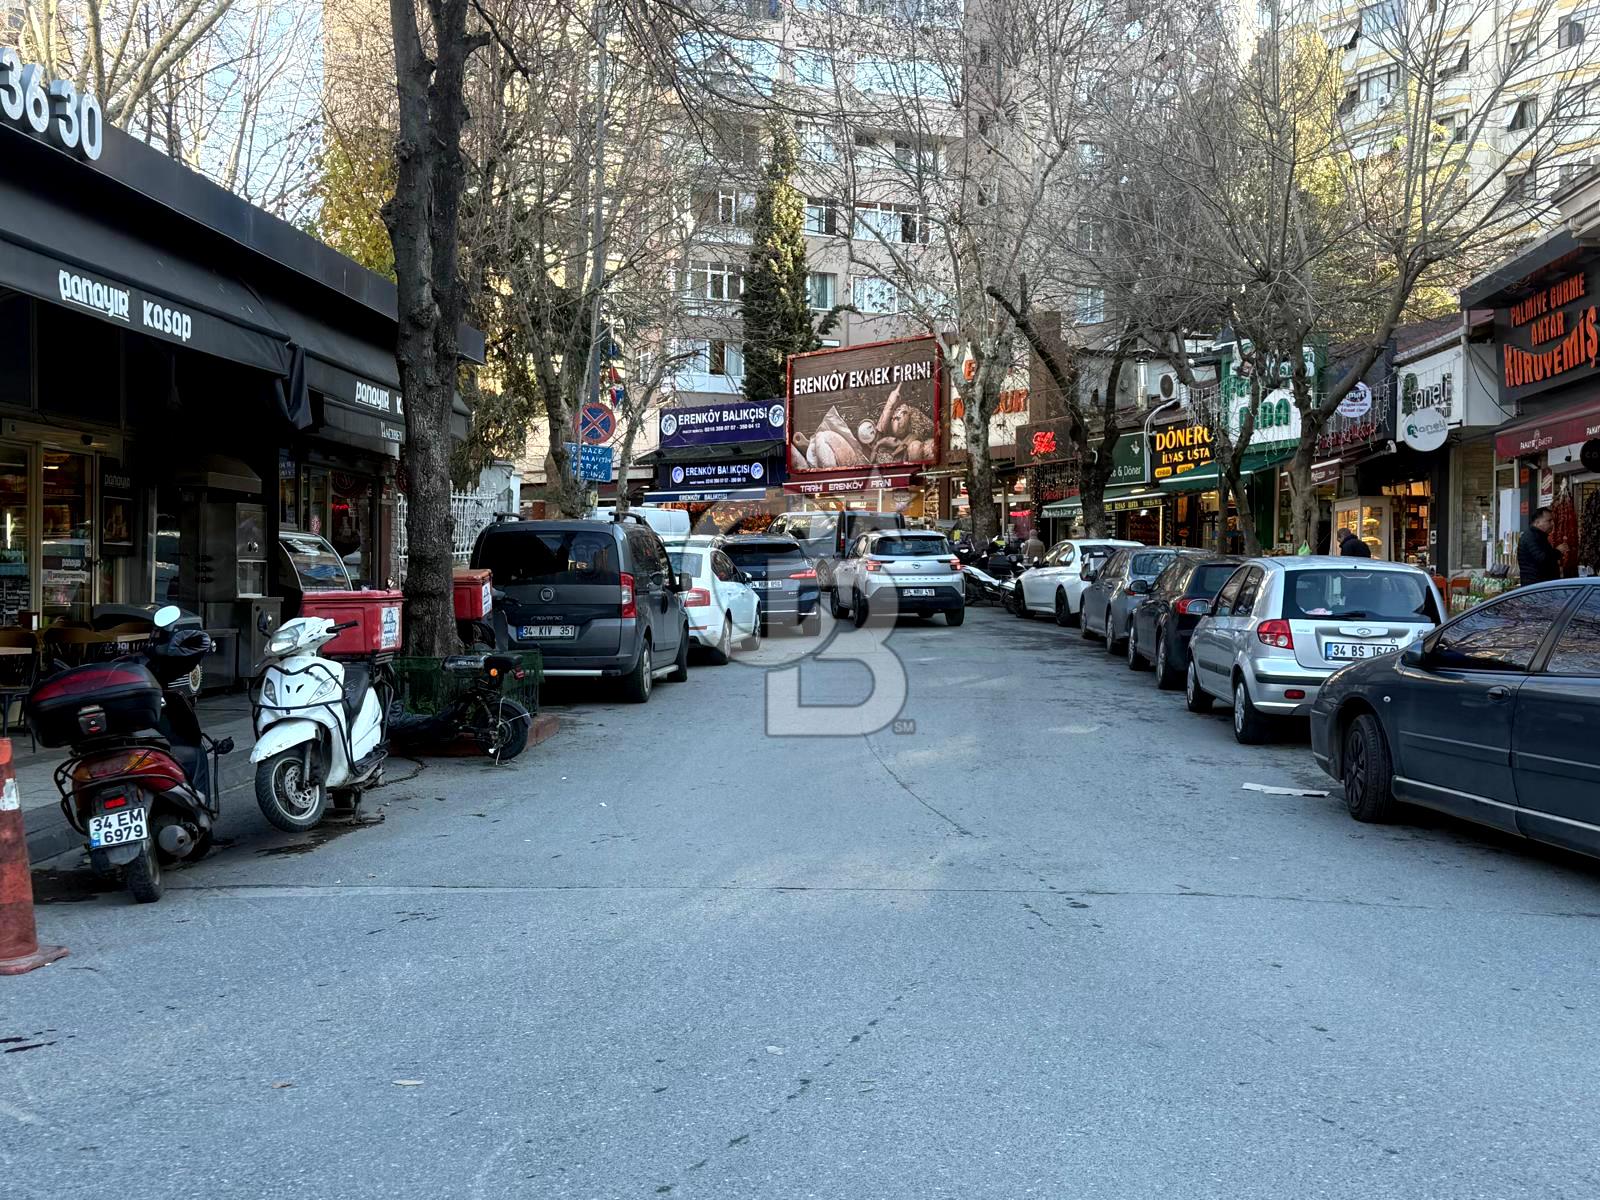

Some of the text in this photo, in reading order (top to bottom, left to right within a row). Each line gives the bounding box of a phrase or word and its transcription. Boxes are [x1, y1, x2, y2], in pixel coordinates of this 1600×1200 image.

[0, 48, 102, 161] 36 30
[1510, 272, 1585, 328] PALMİYE GURME
[1531, 311, 1565, 346] AKTAR
[1504, 305, 1599, 388] KURUYEMİŞ
[793, 361, 931, 395] ERENKÖY EKMEK FIRINI
[678, 409, 720, 425] ERENKÖY
[1156, 425, 1214, 451] DÖNERC
[571, 446, 603, 455] CNAZE
[1162, 447, 1210, 464] İLYAS USTA
[685, 464, 716, 476] ERENKÖY
[1123, 466, 1142, 476] Döner
[828, 481, 864, 491] ERENKÖY
[679, 493, 701, 501] ERENKÖY
[524, 626, 533, 636] 34
[560, 626, 574, 636] 351
[1333, 645, 1346, 657] 34
[1351, 646, 1365, 657] BS
[93, 808, 143, 832] 34 EM
[104, 824, 144, 843] 6979
